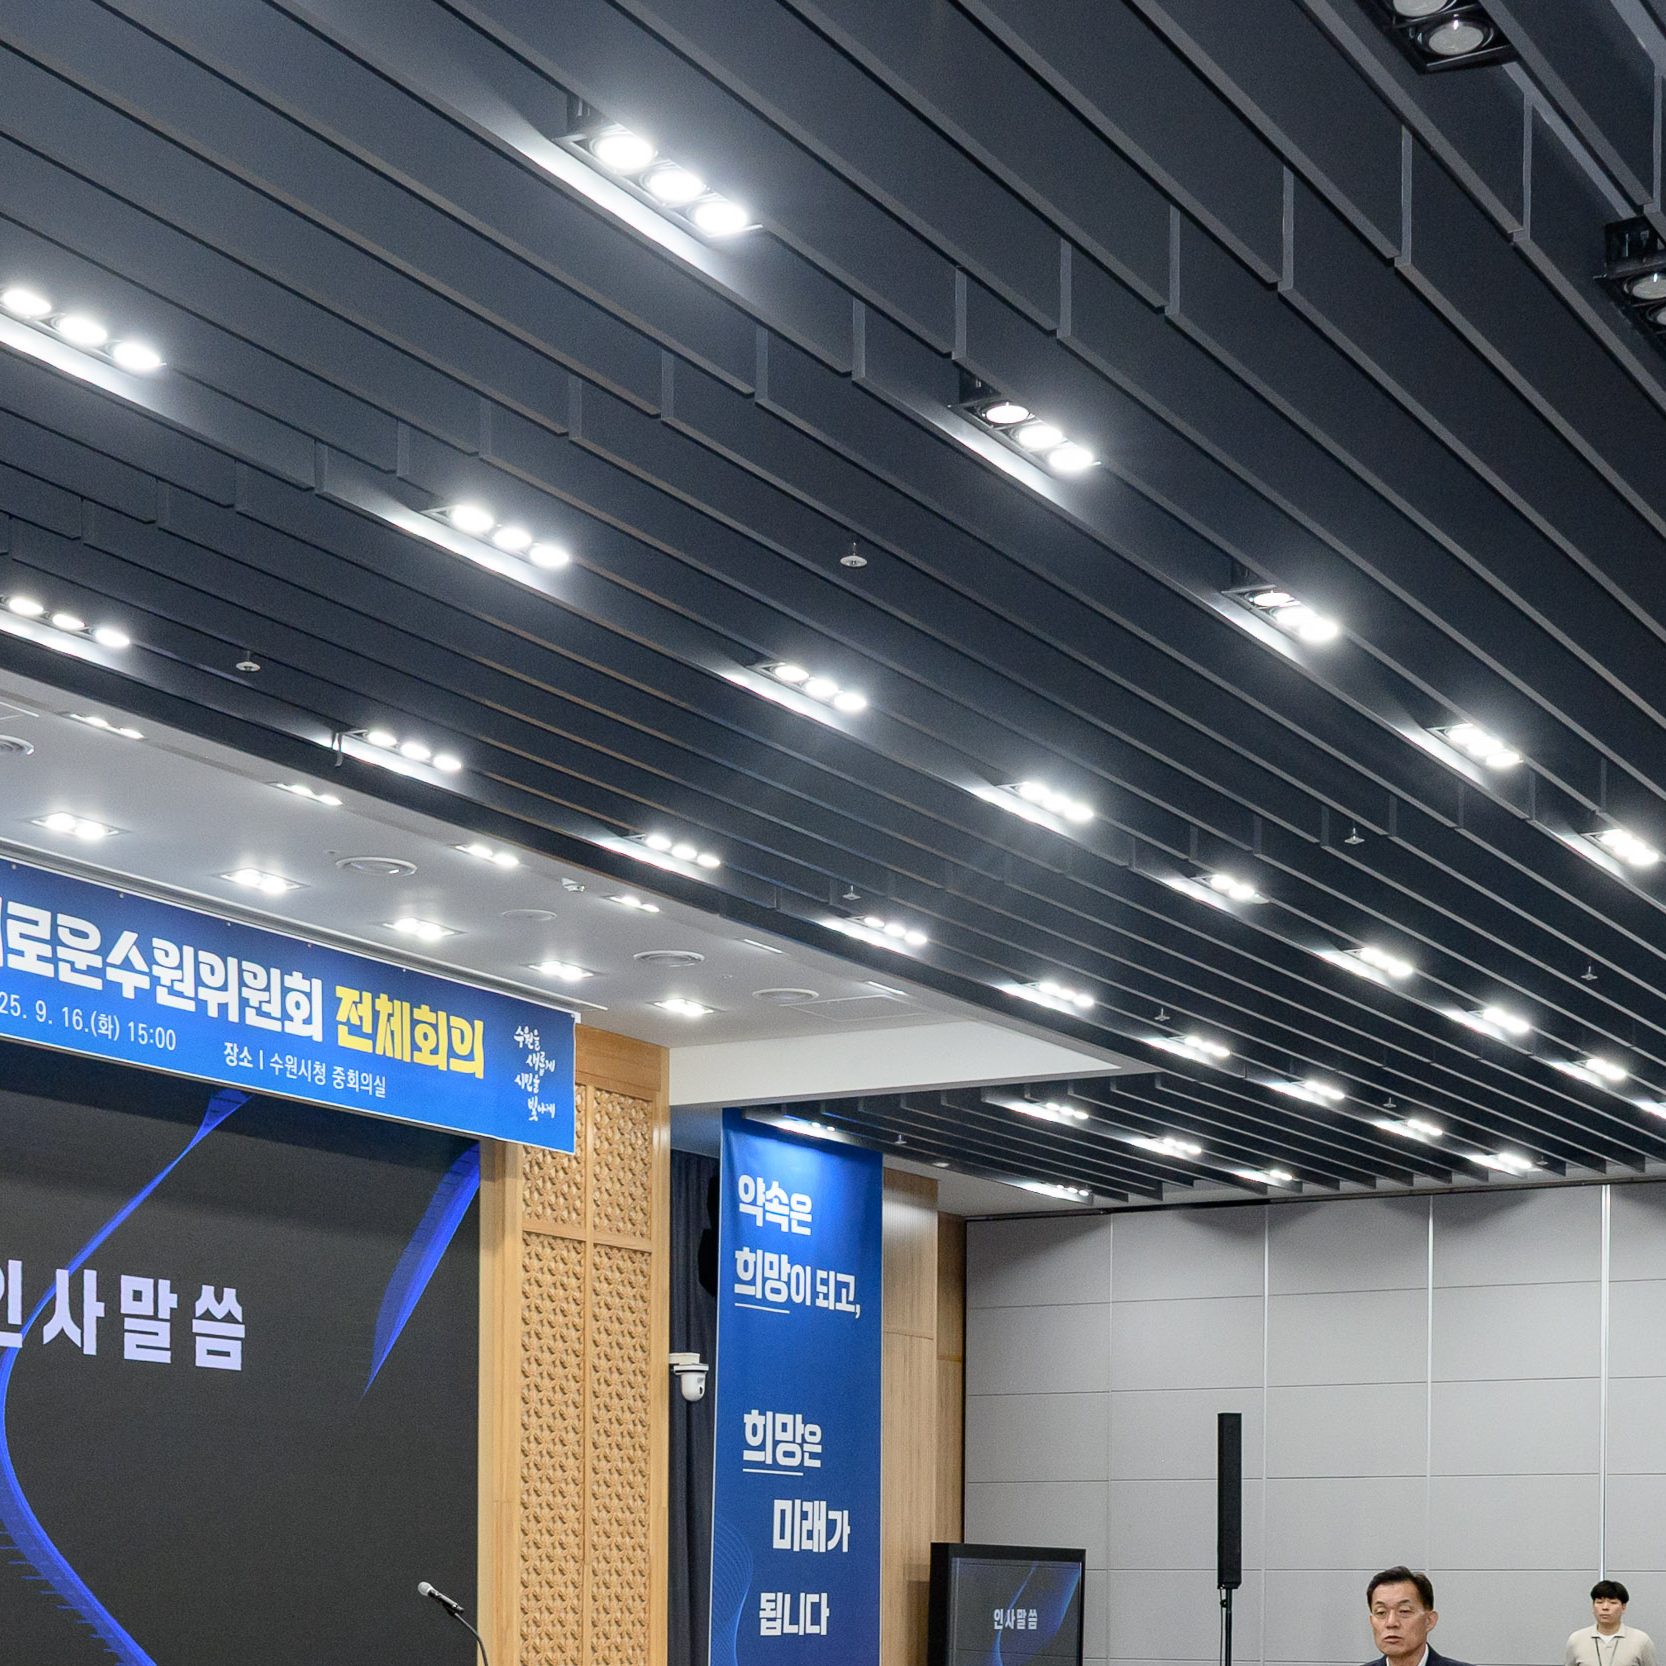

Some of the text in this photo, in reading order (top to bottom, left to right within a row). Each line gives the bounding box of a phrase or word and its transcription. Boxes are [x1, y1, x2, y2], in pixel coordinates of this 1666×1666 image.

[34, 1000, 54, 1025] 9.
[61, 1006, 121, 1042] 16.(화)
[126, 1021, 178, 1052] 15:00
[334, 984, 485, 1079] 전체회의
[513, 1025, 541, 1052] 수원을
[223, 1041, 254, 1070] 장소
[268, 1055, 328, 1086] 수원시청
[330, 1068, 387, 1099] 중회의실
[513, 1072, 541, 1094] 시민을
[525, 1051, 556, 1077] 새롭게
[527, 1095, 556, 1122] 빛나게
[737, 1173, 813, 1236] 약속은
[734, 1246, 862, 1320] 희망이 되고,
[742, 1408, 823, 1469] 희망은
[772, 1498, 851, 1553] 미래가
[758, 1591, 830, 1637] 됩니다
[992, 1608, 1039, 1631] 인사말씀
